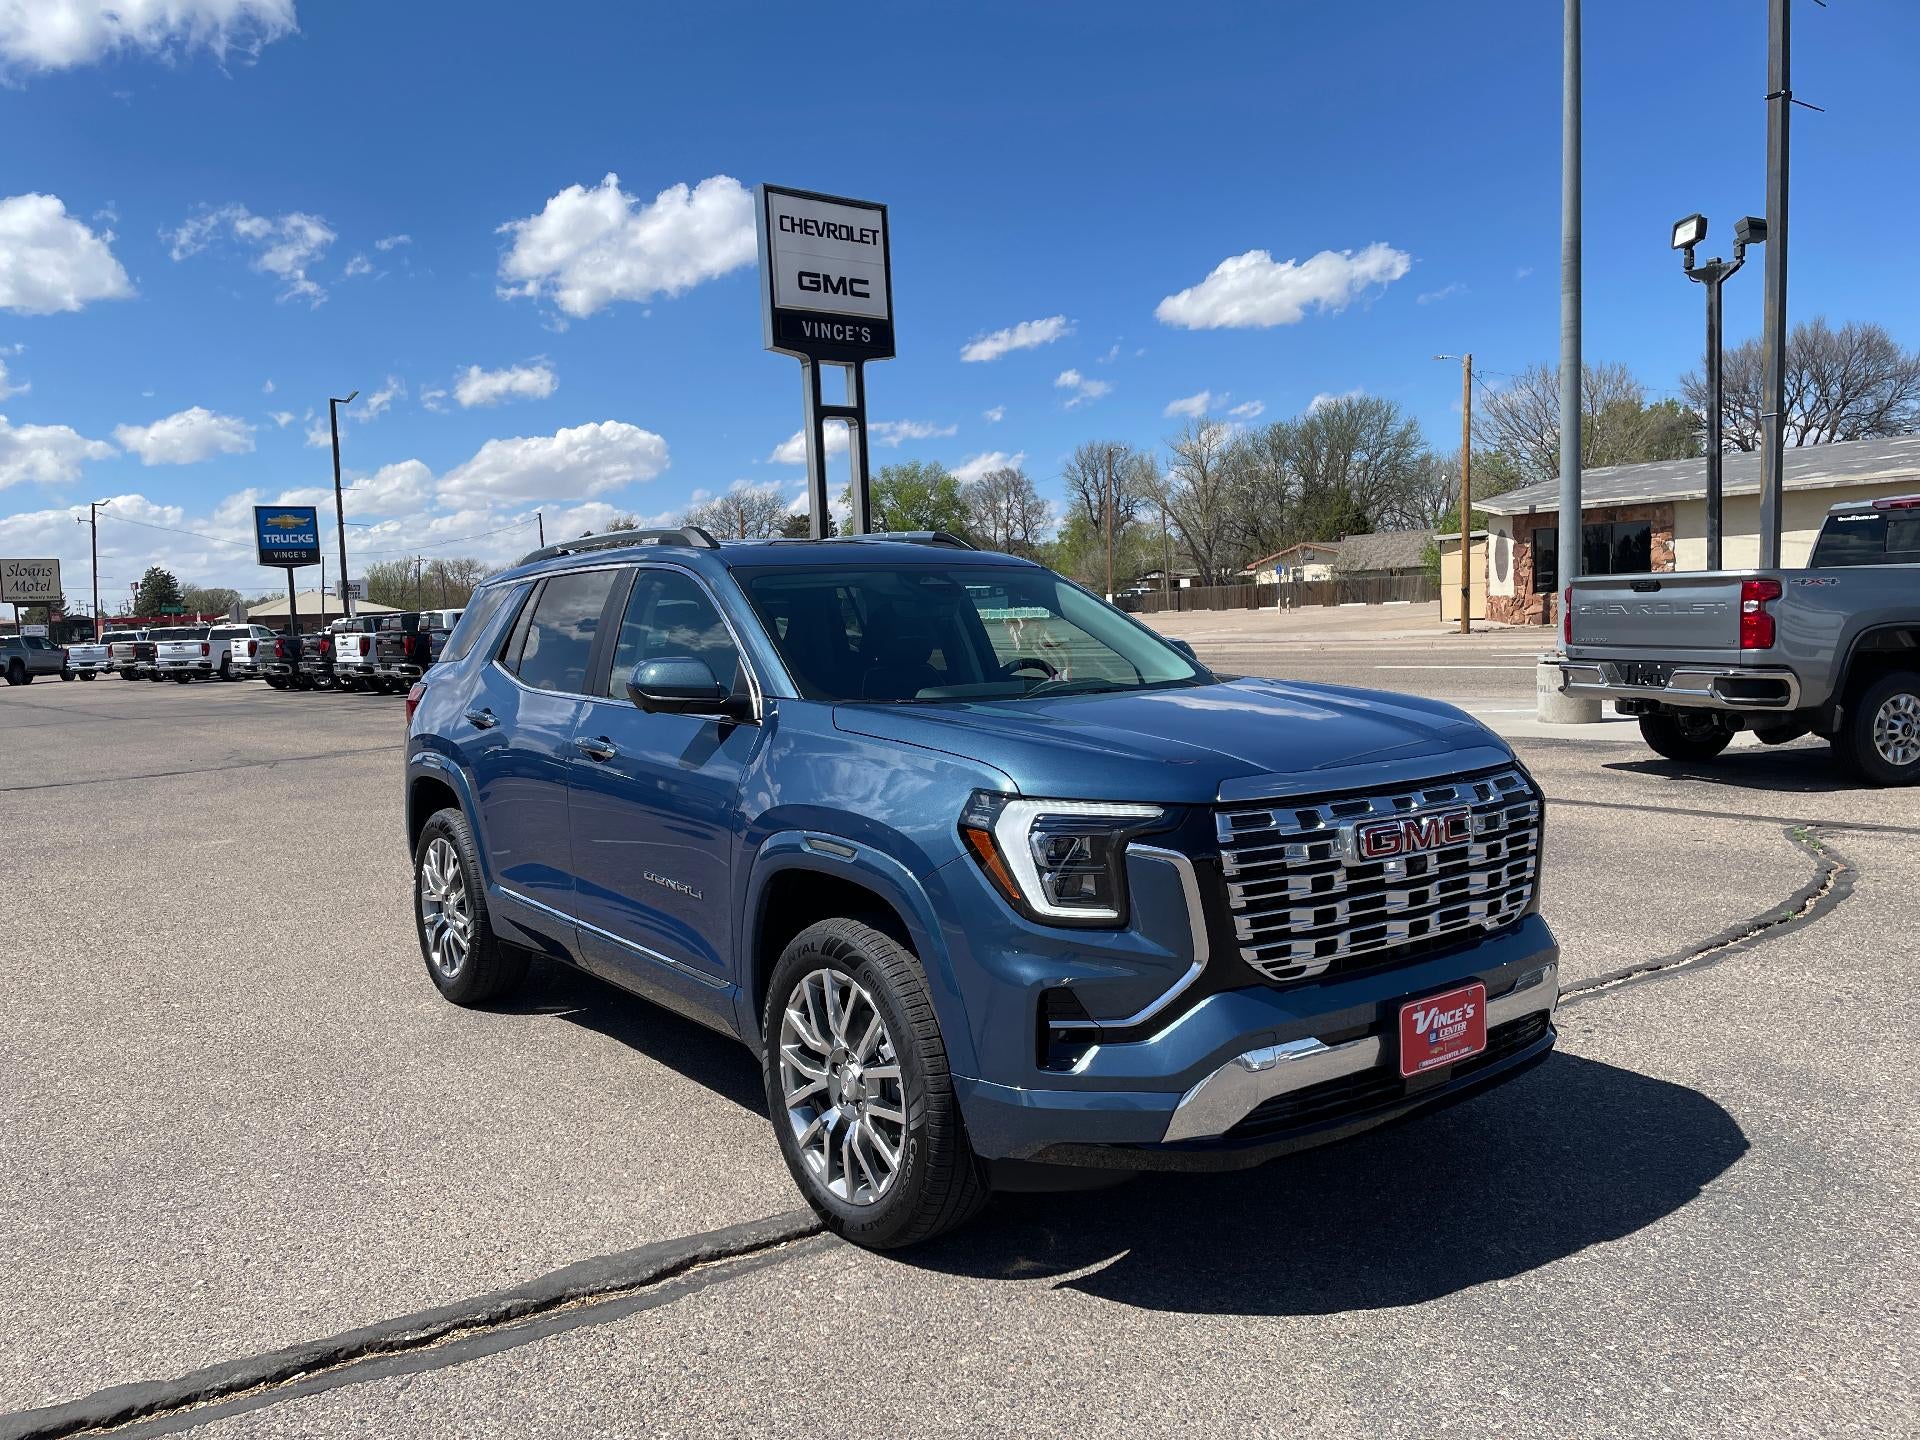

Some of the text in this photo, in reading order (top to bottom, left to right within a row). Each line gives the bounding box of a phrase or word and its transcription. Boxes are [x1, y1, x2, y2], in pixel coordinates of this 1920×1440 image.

[779, 214, 880, 246] CHEVROLET
[797, 270, 871, 299] GMC
[801, 320, 871, 343] VINCE'S
[263, 534, 314, 544] TRUCKS
[273, 551, 307, 559] VINCE'S
[6, 562, 53, 577] Sloans
[10, 578, 51, 593] Motel
[1578, 601, 1729, 616] CHEVROLET
[1361, 811, 1472, 858] GMC
[643, 870, 704, 900] DENALI
[1412, 1003, 1476, 1035] VINCE'S
[1439, 1021, 1468, 1038] CENTER
